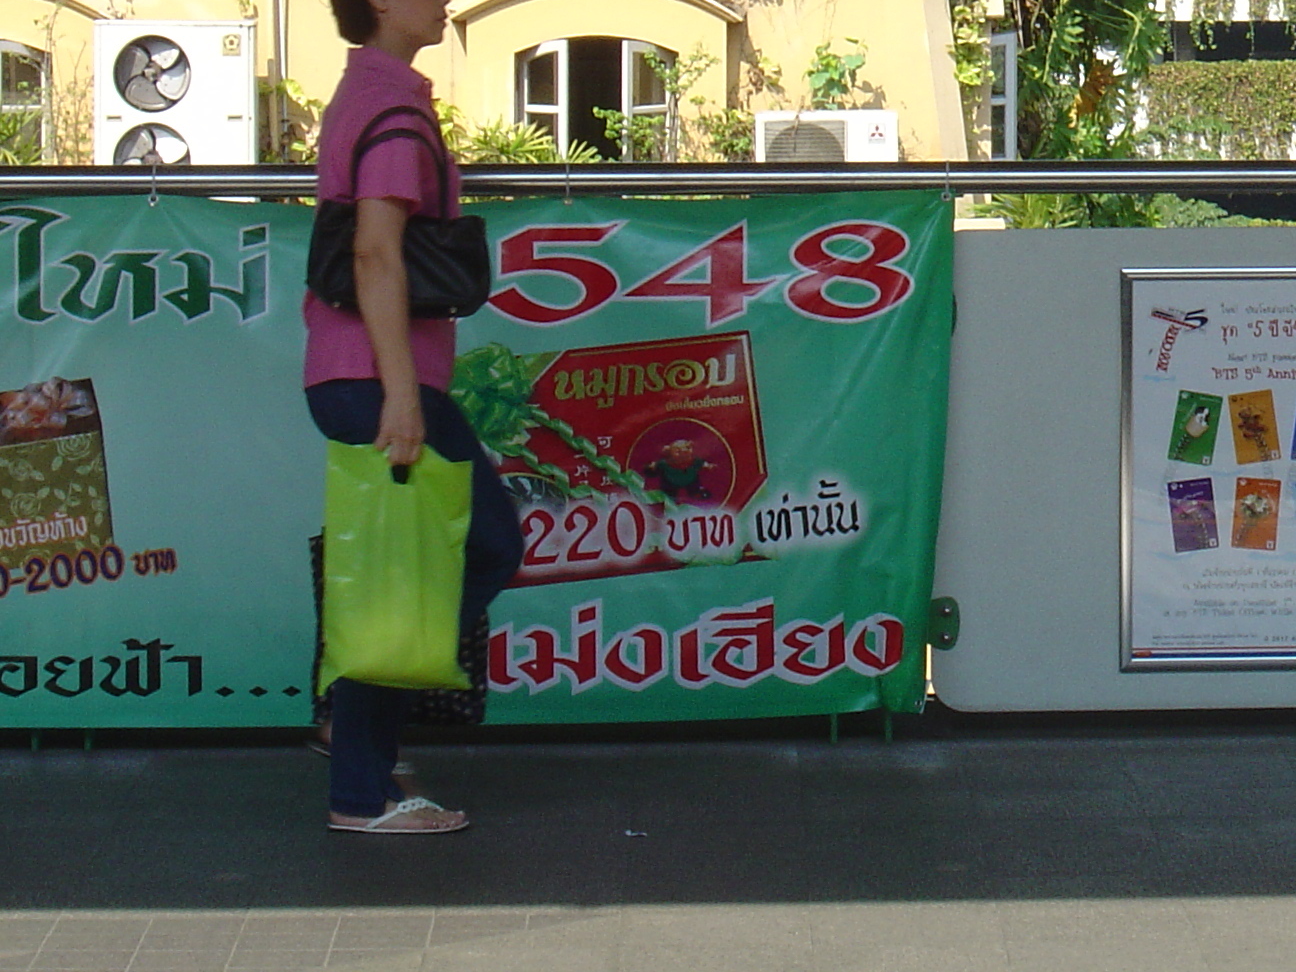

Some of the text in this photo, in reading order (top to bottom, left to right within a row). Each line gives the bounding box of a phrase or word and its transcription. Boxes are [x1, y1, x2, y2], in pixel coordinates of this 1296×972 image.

[554, 354, 736, 408] หมูกรอบ
[667, 512, 735, 551] บาท
[754, 479, 860, 544] เท่านั้น
[130, 548, 178, 576] บาท
